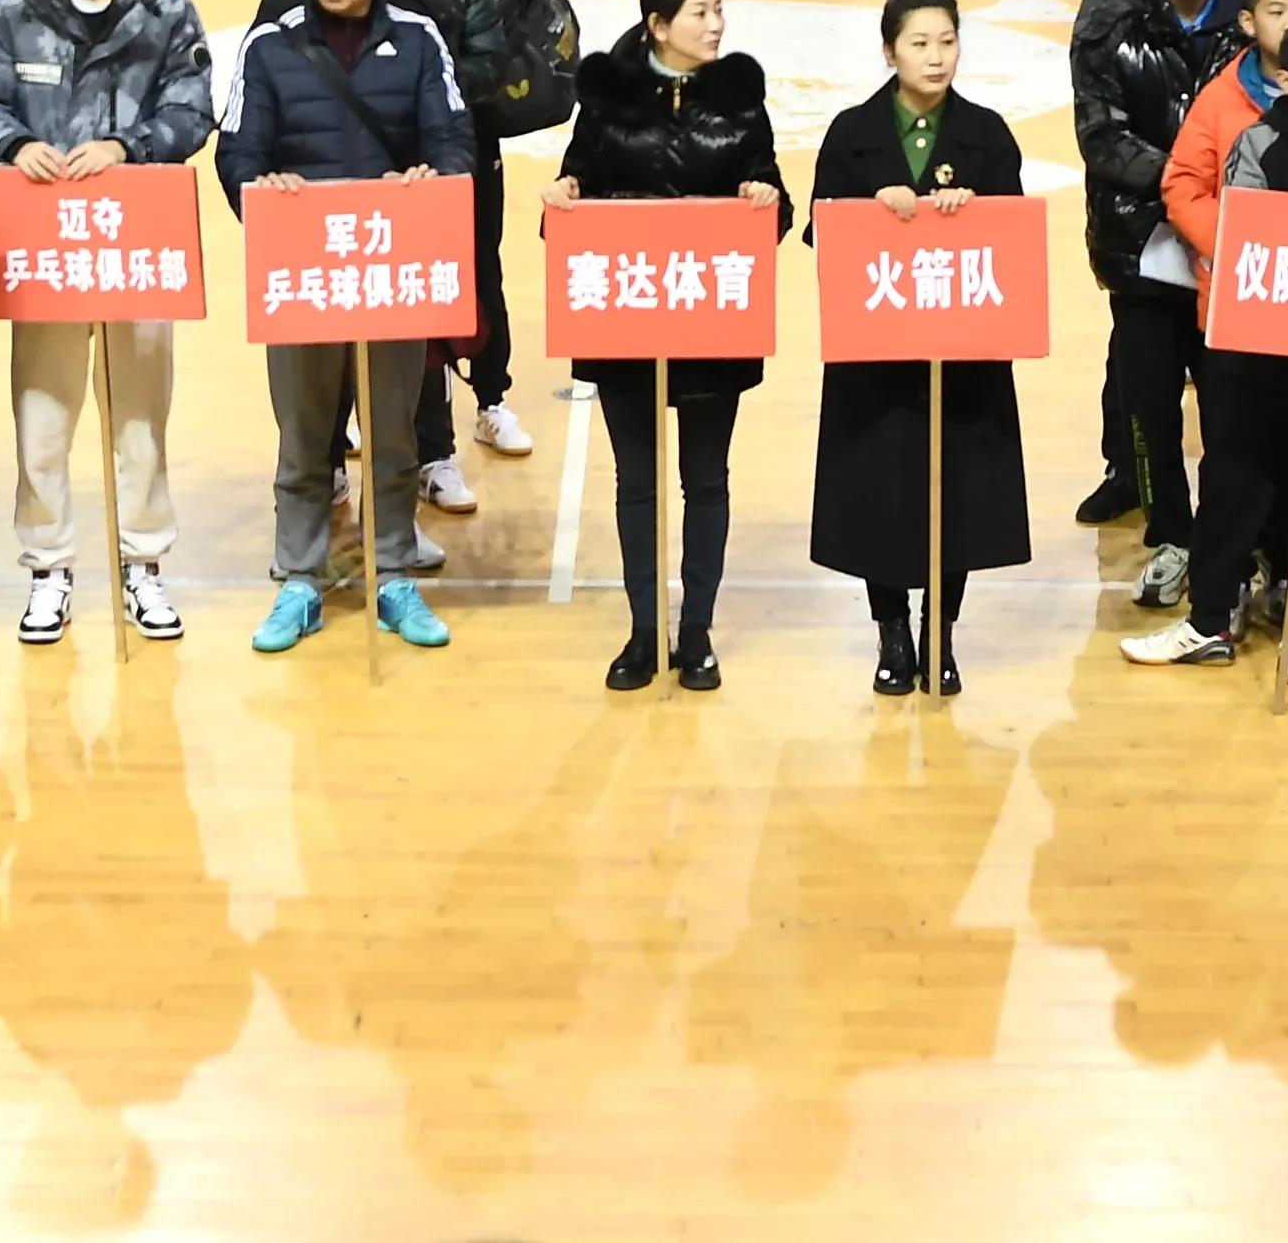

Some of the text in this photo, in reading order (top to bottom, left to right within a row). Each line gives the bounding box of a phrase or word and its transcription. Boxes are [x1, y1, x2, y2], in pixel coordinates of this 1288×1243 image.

[58, 197, 123, 240] 迈夺
[325, 210, 392, 258] 军力
[7, 248, 188, 292] 乒乓球俱乐部
[264, 260, 460, 314] 乒乓球俱乐部
[567, 251, 755, 311] 赛达体育
[865, 246, 1004, 311] 火箭队
